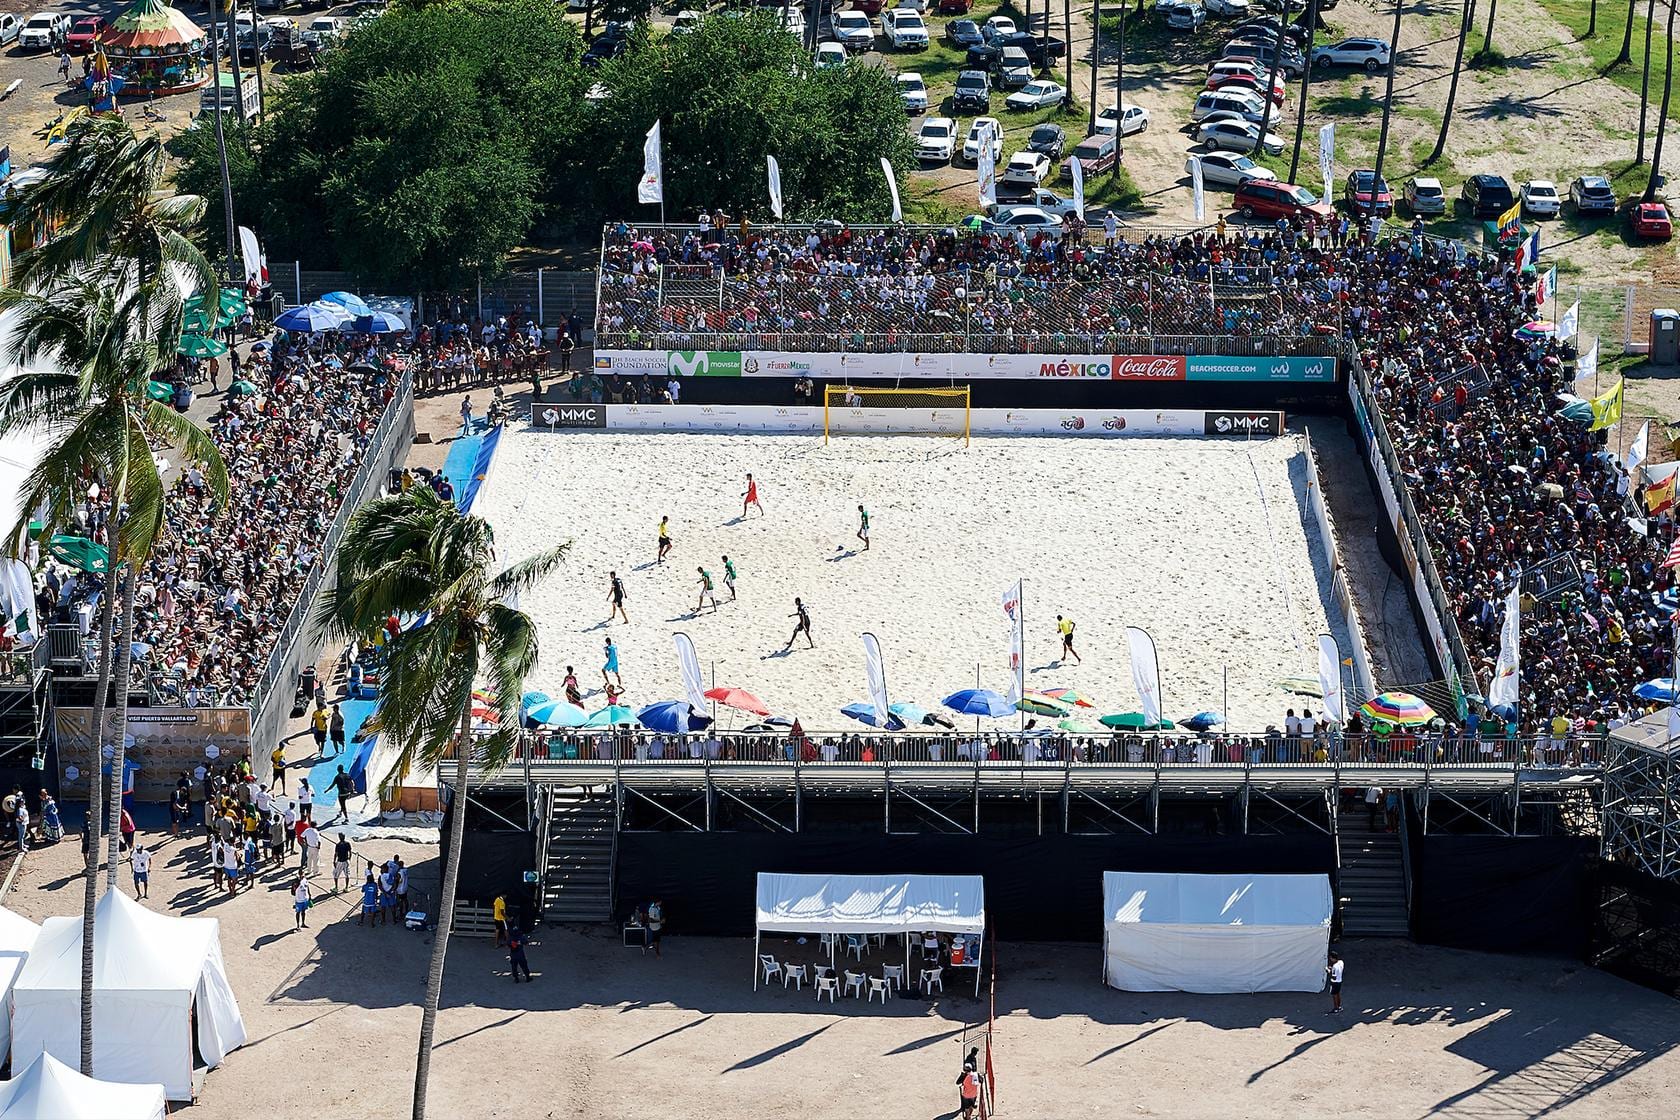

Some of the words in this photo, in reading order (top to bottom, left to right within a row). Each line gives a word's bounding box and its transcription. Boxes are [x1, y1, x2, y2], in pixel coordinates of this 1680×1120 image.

[1119, 358, 1179, 377] Coca-Cola
[1190, 365, 1256, 373] BEACHSOCCER.COM
[561, 409, 596, 421] MMC
[1233, 417, 1269, 428] MMC
